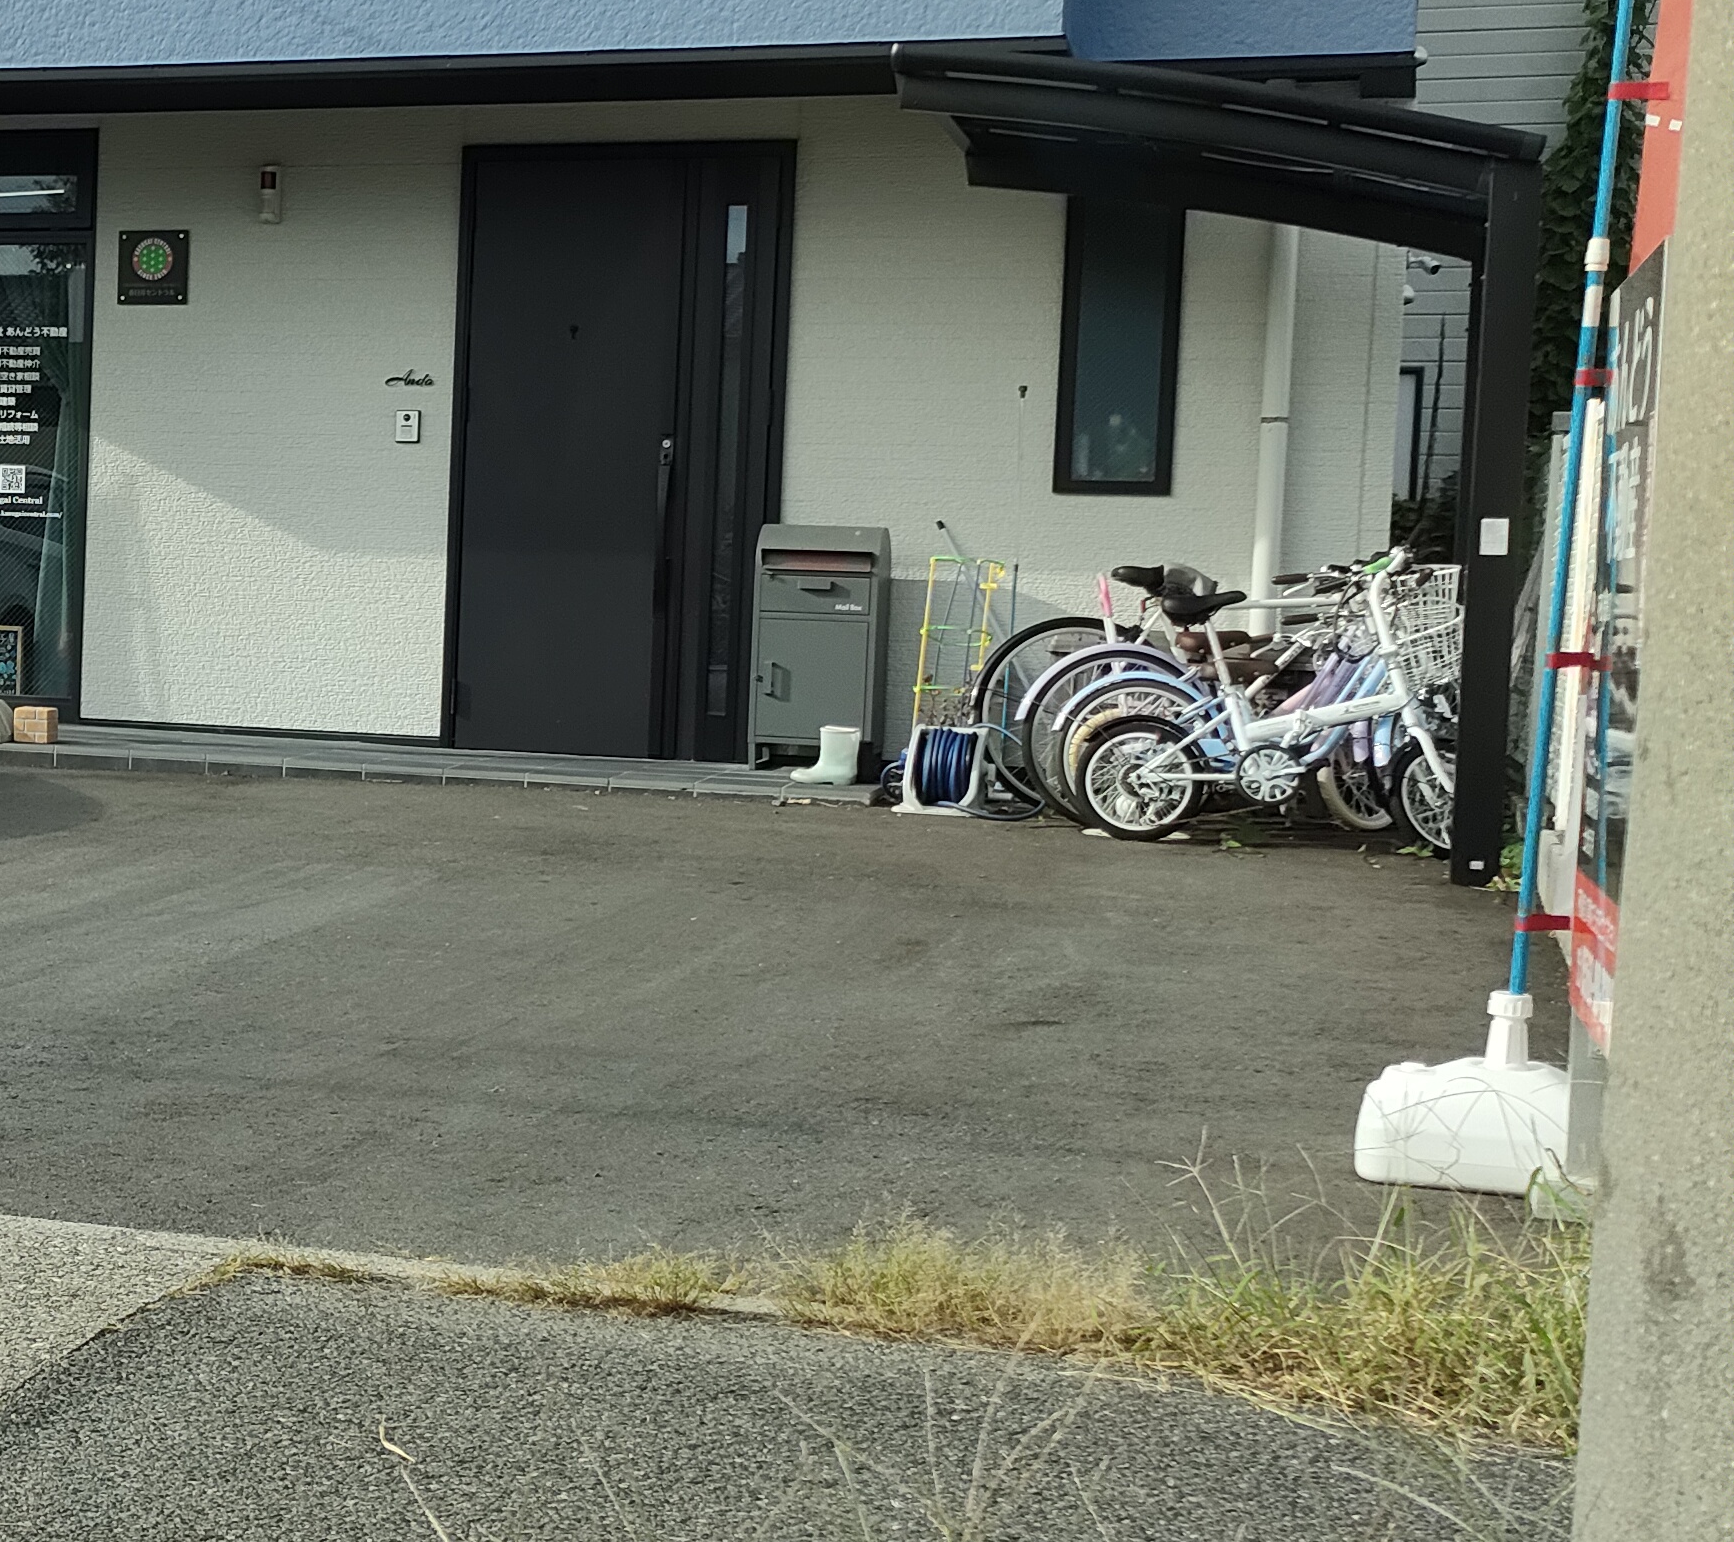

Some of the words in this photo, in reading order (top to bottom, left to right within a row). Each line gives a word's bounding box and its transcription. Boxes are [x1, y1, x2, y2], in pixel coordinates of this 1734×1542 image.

[5, 326, 68, 337] あんどう不動産
[0, 409, 39, 419] リフォーム
